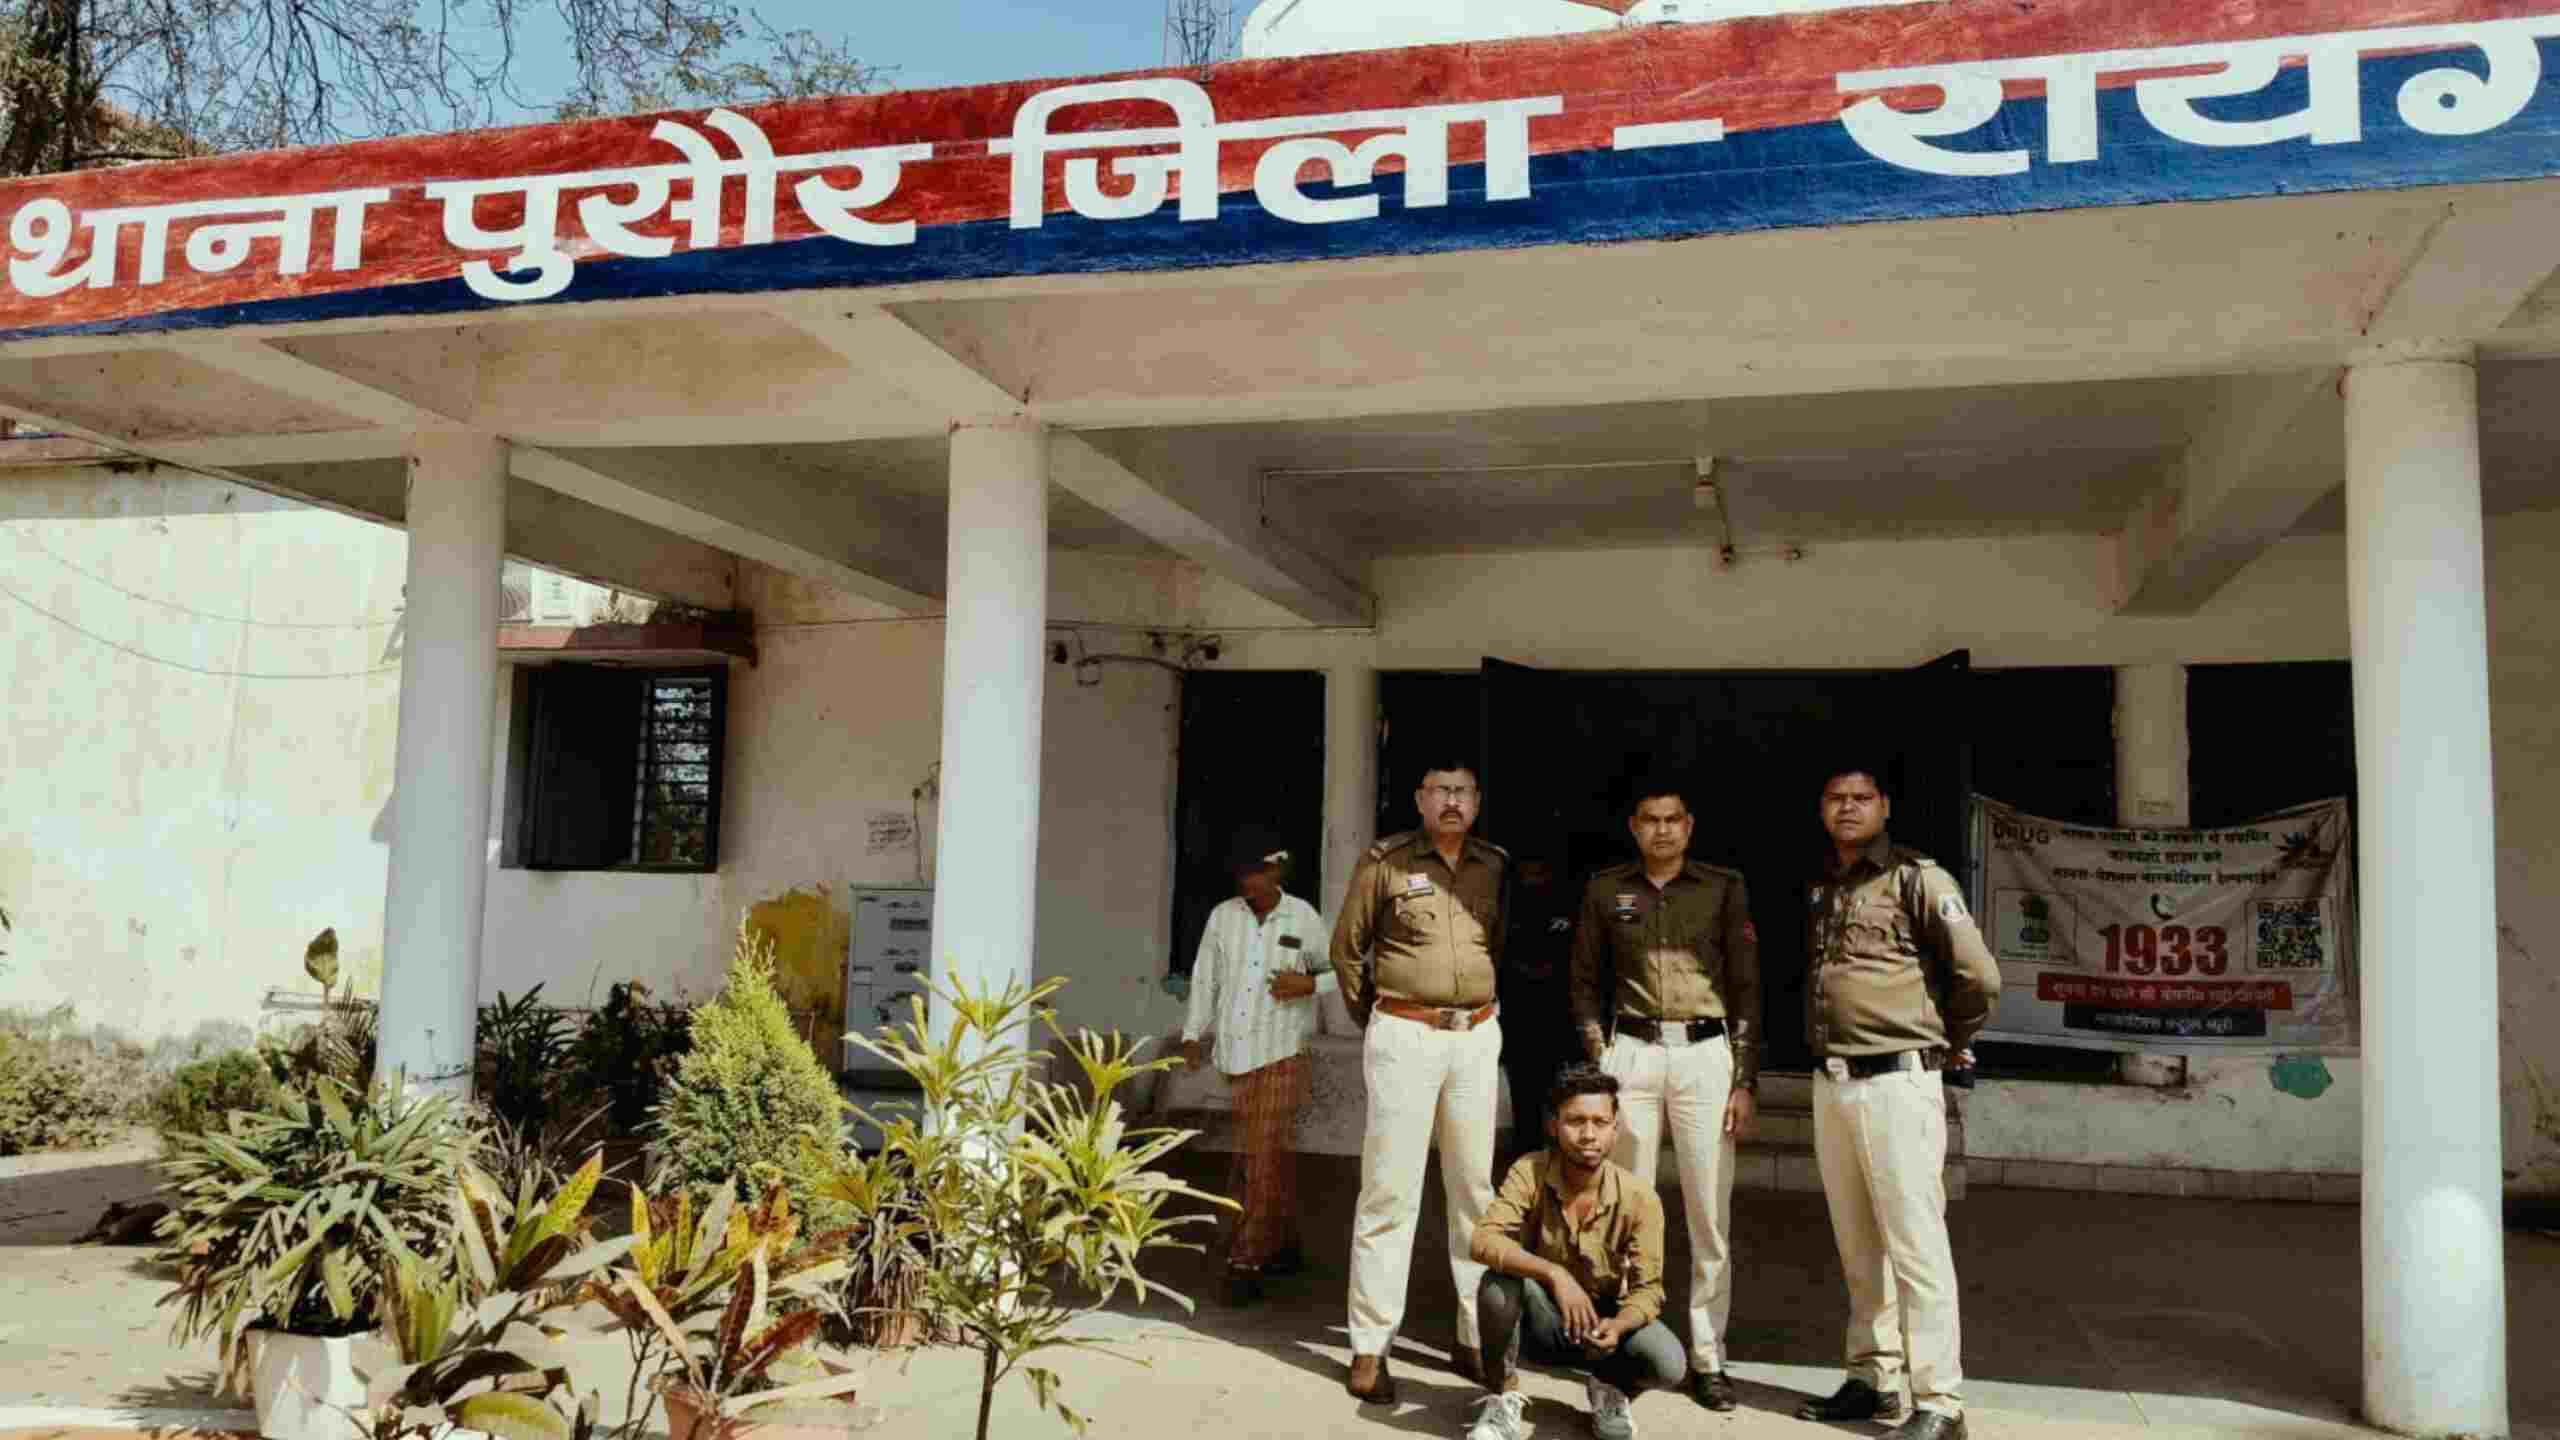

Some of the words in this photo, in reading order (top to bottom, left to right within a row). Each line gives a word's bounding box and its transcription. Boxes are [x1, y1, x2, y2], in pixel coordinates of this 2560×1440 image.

[10, 188, 390, 297] थाना
[426, 108, 932, 300] पुसौर
[988, 78, 1563, 229] जिला
[2098, 923, 2228, 976] 1933
